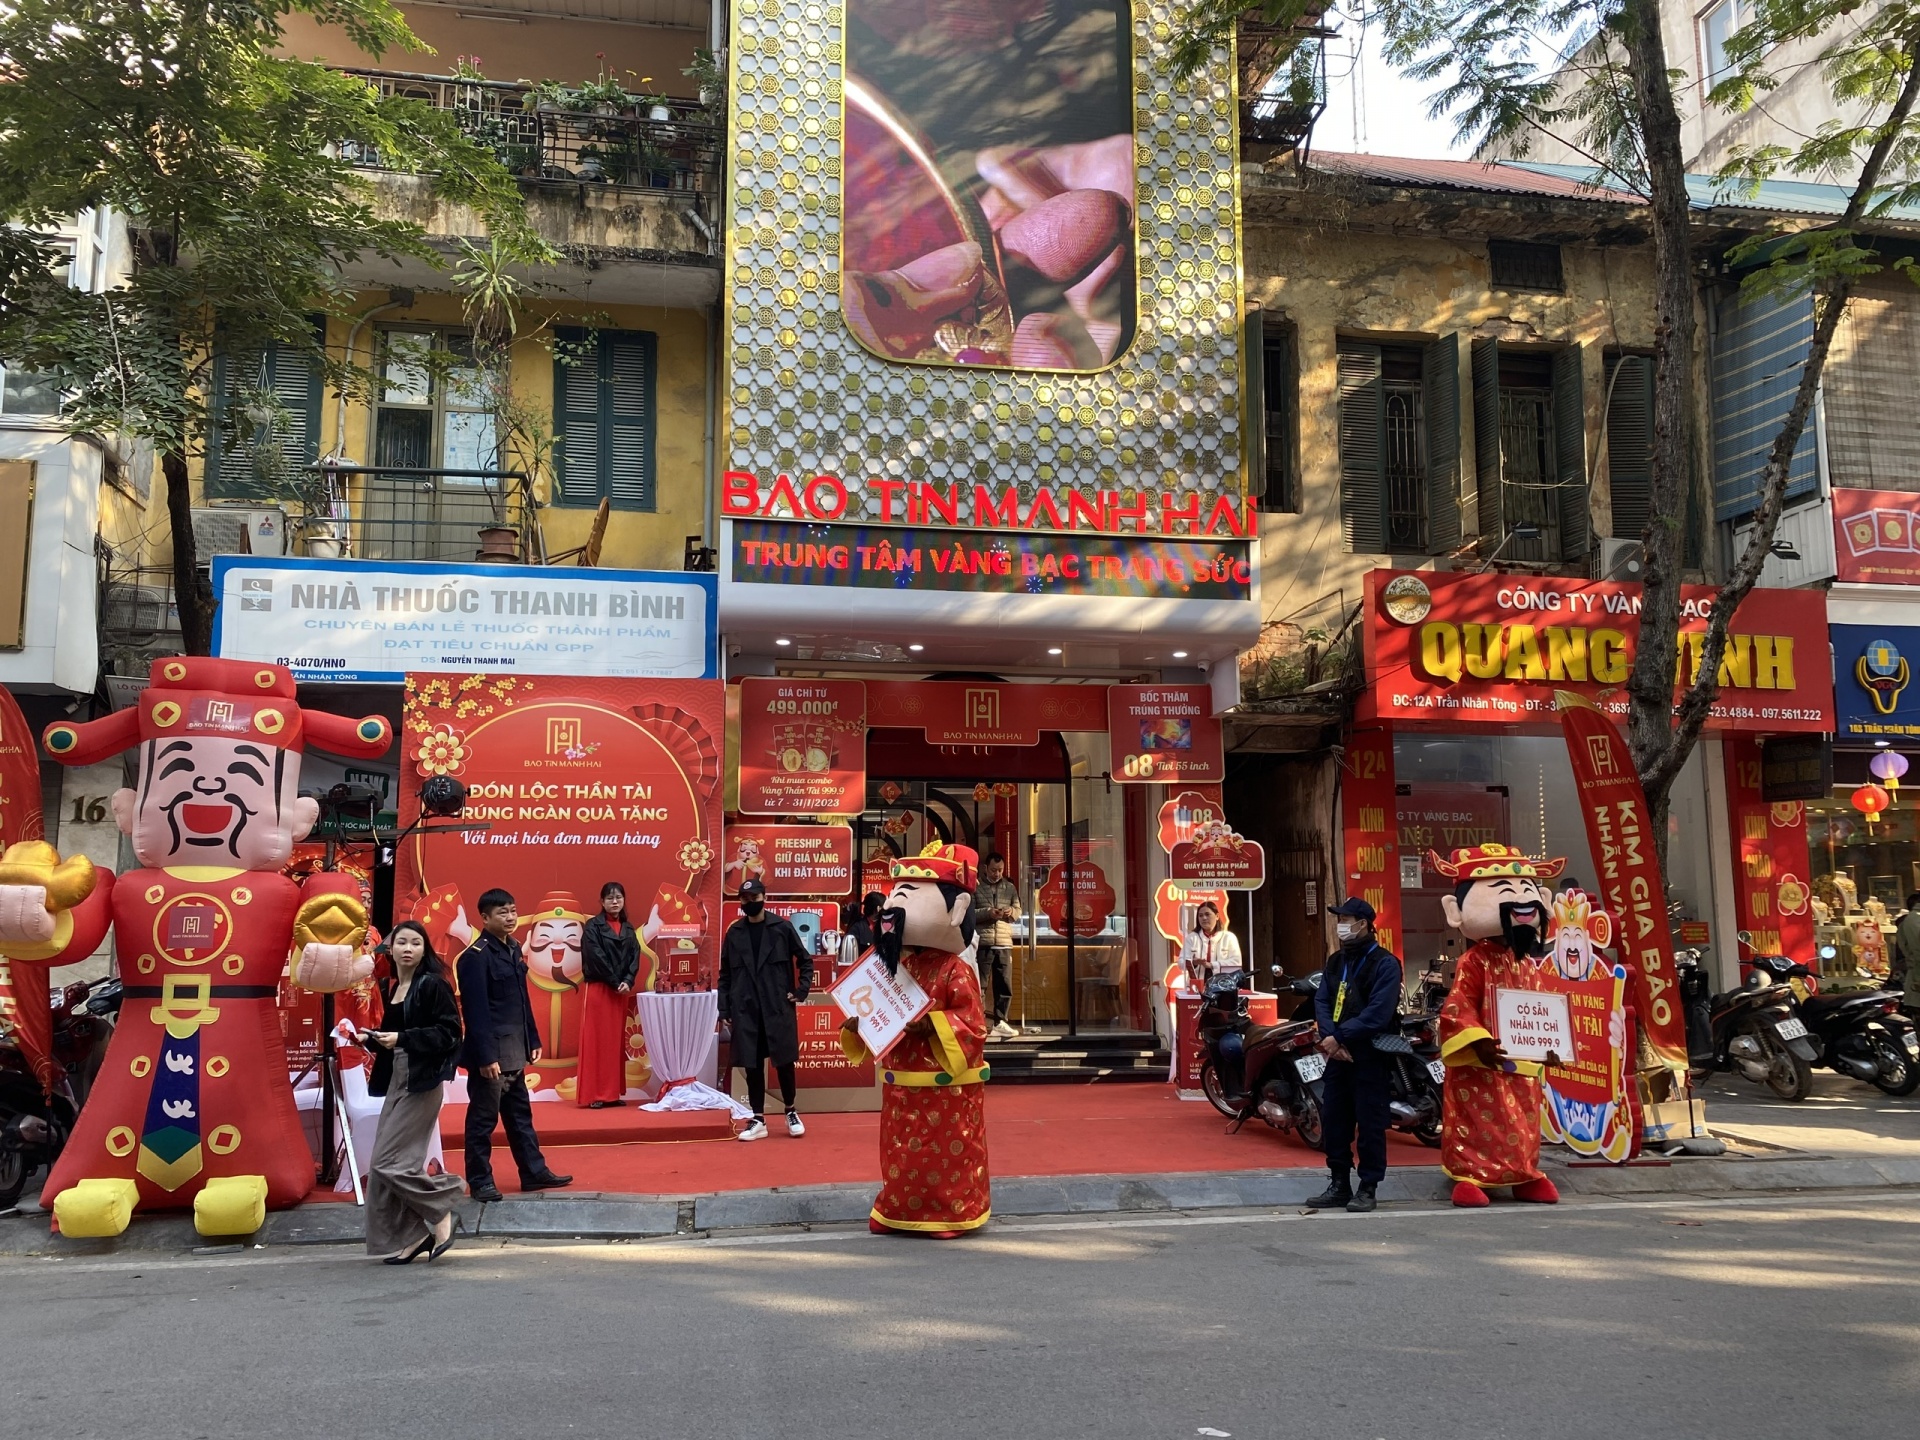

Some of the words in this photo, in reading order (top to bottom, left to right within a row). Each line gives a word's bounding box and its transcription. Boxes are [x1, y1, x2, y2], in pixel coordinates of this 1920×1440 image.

[722, 469, 847, 520] BAO
[741, 539, 848, 569] TRUNG
[858, 539, 922, 574] TÂM
[930, 542, 1013, 577] VÀNG
[1021, 552, 1080, 583] BẠC
[1086, 555, 1194, 583] TRANG
[1193, 552, 1252, 585] SỨC
[291, 579, 362, 611] NHÀ
[373, 579, 480, 614] THUỐC
[494, 589, 598, 618] THANH
[615, 588, 685, 620] BÌNH
[1496, 586, 1561, 612] CÔNG
[1565, 593, 1596, 614] TY
[1602, 590, 1643, 616] VÀN
[1680, 597, 1712, 623] ẠC
[303, 616, 387, 632] CHUYÊN
[394, 618, 435, 633] BÁN
[444, 616, 466, 633] LẺ
[472, 618, 540, 635] THUỐC
[546, 621, 611, 637] THÀNH
[617, 621, 672, 641] PHẨM
[383, 637, 426, 652] ĐẠT
[433, 636, 475, 652] TIÊU
[480, 636, 549, 653] CHUẨN
[554, 641, 595, 654] GPP
[1420, 620, 1628, 685] QUANG
[441, 654, 472, 665] NGUYỄN
[474, 656, 499, 665] THANH
[500, 657, 516, 666] MAI
[307, 673, 332, 681] NHÂN
[334, 672, 358, 681] TÔNG
[778, 688, 794, 698] GIÁ
[796, 687, 813, 698] CHỈ
[815, 687, 828, 698] TỪ
[1140, 689, 1160, 703] BỐC
[1161, 691, 1189, 703] THĂM
[1129, 703, 1160, 715] TRÚNG
[1163, 703, 1201, 716] THƯỞNG
[1436, 694, 1459, 708] Trần
[1461, 696, 1489, 709] Nhân
[1491, 697, 1517, 713] Tông
[1761, 709, 1822, 721] 097.5611.222
[943, 731, 962, 739] BAO
[979, 732, 1006, 740] MANH
[524, 759, 543, 767] BAO
[558, 760, 585, 768] MANH
[1124, 754, 1154, 777] 08
[1175, 762, 1188, 771] 55
[1189, 762, 1210, 771] inch
[1351, 750, 1387, 779] 12A
[770, 776, 785, 784] Khi
[807, 776, 833, 784] combo
[470, 783, 516, 799] ĐÓN
[519, 781, 559, 801] LỘC
[563, 781, 618, 799] THẦN
[622, 782, 652, 800] TÀI
[760, 786, 783, 796] Vàng
[822, 786, 845, 795] 999.9
[71, 795, 107, 823] 16
[764, 798, 776, 807] từ
[778, 798, 783, 806] 7
[792, 798, 840, 809] 31/1/2023
[518, 805, 572, 821] NGÀN
[576, 806, 613, 824] QUÀ
[618, 805, 668, 824] TẶNG
[1192, 808, 1213, 824] 08
[1359, 803, 1385, 833] KÍNH
[1407, 811, 1420, 821] TY
[1423, 809, 1450, 822] VÀNG
[1452, 812, 1473, 824] BẠC
[1617, 800, 1645, 866] KIM
[1744, 811, 1768, 840] KÍNH
[460, 830, 487, 845] Với
[490, 832, 518, 848] mọi
[521, 830, 550, 845] hóa
[553, 831, 582, 845] đơn
[585, 834, 620, 846] mua
[622, 830, 662, 849] hàng
[775, 838, 822, 849] FREESHIP
[824, 838, 832, 849] &
[1442, 826, 1497, 847] VINH
[775, 851, 793, 863] GIỮ
[794, 850, 811, 863] GIÁ
[813, 850, 839, 863] VÀNG
[1184, 860, 1201, 870] QUẦY
[1202, 861, 1215, 869] BÁN
[1216, 860, 1230, 869] SẢN
[1230, 860, 1250, 869] PHẨM
[1357, 843, 1385, 873] CHÀO
[1746, 849, 1772, 878] CHÀO
[775, 867, 791, 877] KHI
[793, 867, 813, 880] ĐẶT
[813, 866, 848, 878] TRƯỚC
[1081, 869, 1094, 879] PHÍ
[1198, 869, 1216, 877] VÀNG
[1077, 879, 1097, 889] CÔNG
[1192, 879, 1204, 888] CHỈ
[1205, 879, 1214, 888] TỪ
[1364, 884, 1385, 914] QUÝ
[1630, 876, 1655, 940] GIA
[1751, 889, 1770, 919] QUÝ
[1641, 948, 1673, 1027] BẢO
[899, 993, 915, 1012] CÔNG
[1517, 1002, 1531, 1015] CÓ
[1532, 1001, 1549, 1017] SẴN
[1582, 993, 1605, 1010] VÀNG
[875, 1008, 891, 1027] VÀNG
[1510, 1015, 1534, 1031] NHẪN
[1536, 1021, 1540, 1031] 1
[1542, 1020, 1559, 1032] CHỈ
[1582, 1013, 1603, 1037] TÀI
[811, 1041, 826, 1051] 55
[1511, 1034, 1536, 1046] VÀNG
[1537, 1038, 1560, 1049] 999.9
[805, 1061, 822, 1070] LỘC
[821, 1059, 845, 1069] THẦN
